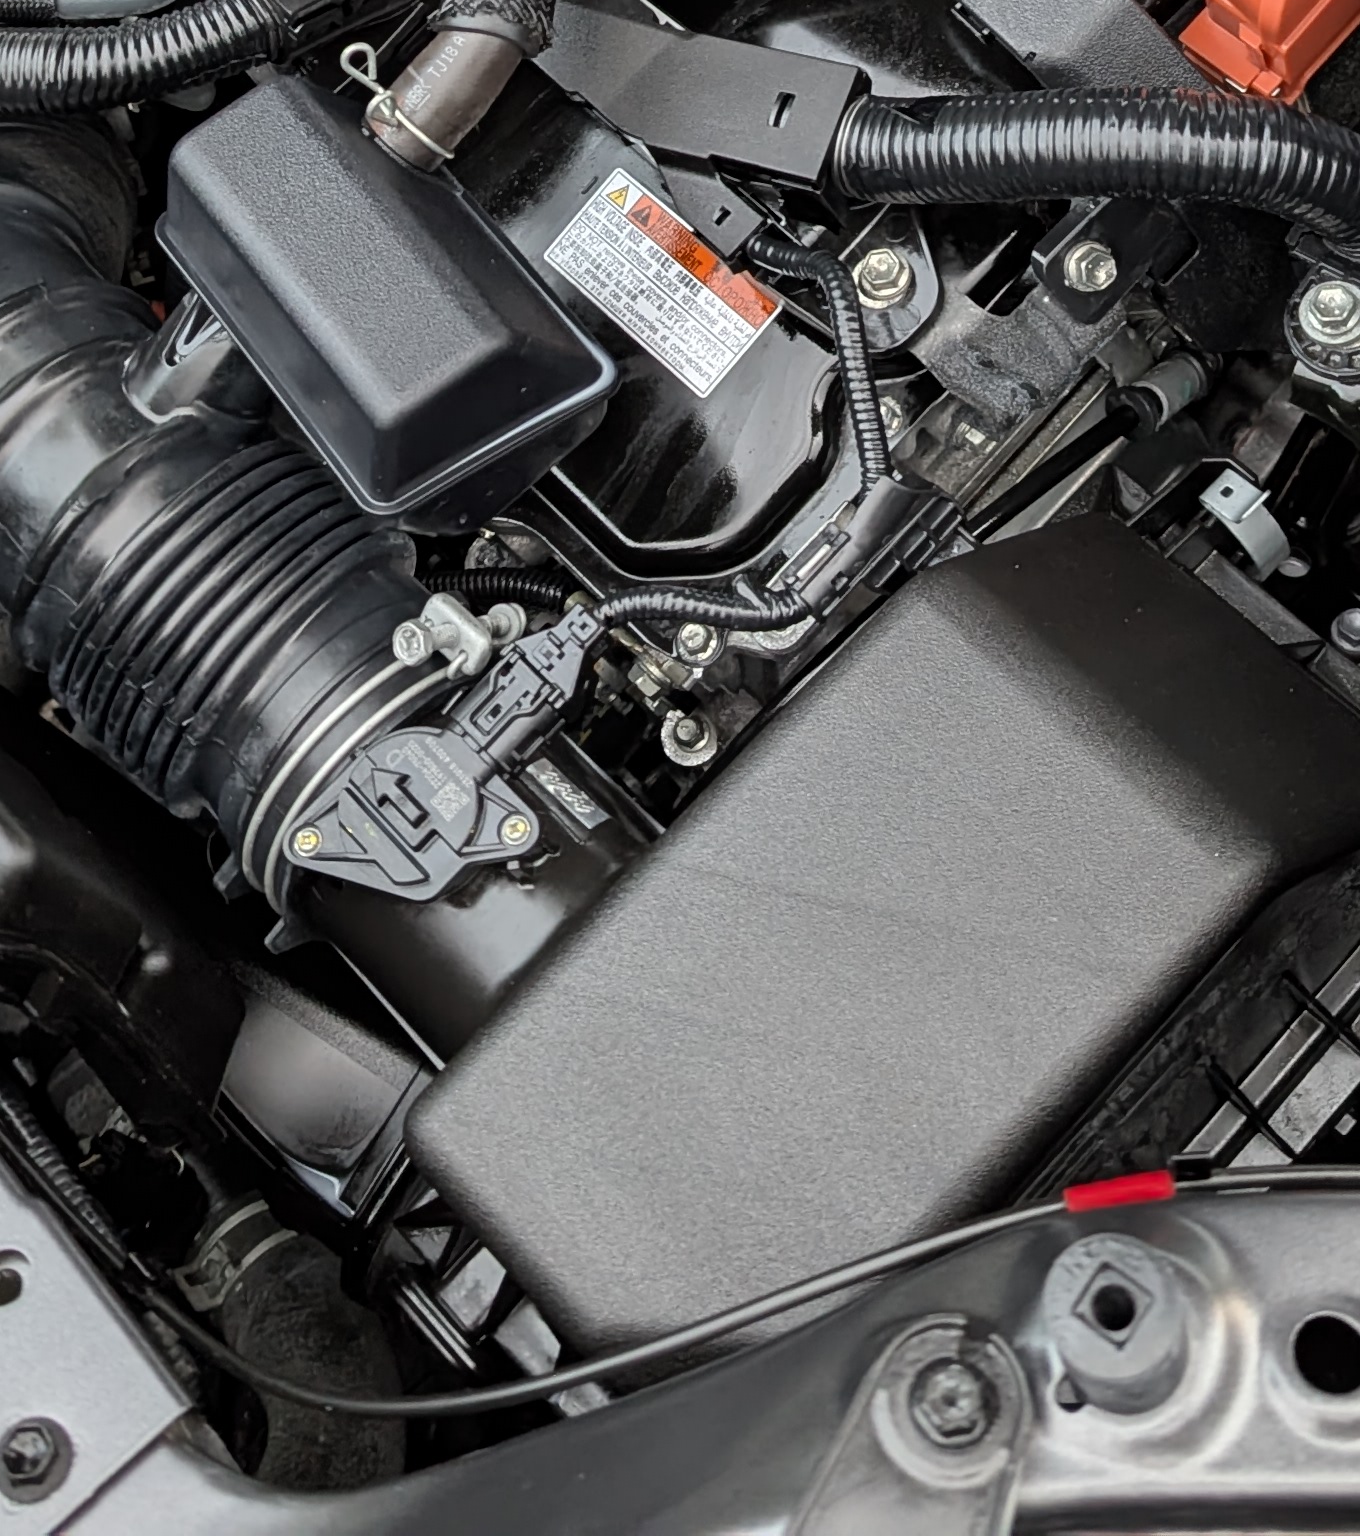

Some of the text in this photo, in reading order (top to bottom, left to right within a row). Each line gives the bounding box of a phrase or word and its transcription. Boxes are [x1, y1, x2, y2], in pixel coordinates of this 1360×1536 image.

[585, 231, 603, 248] NOT
[589, 197, 647, 248] HIGH VOLTAGE INSIDE
[655, 212, 701, 253] WARNING
[567, 251, 586, 270] PAS
[582, 265, 610, 291] enlever
[607, 287, 624, 303] ces
[621, 299, 661, 336] couvercles
